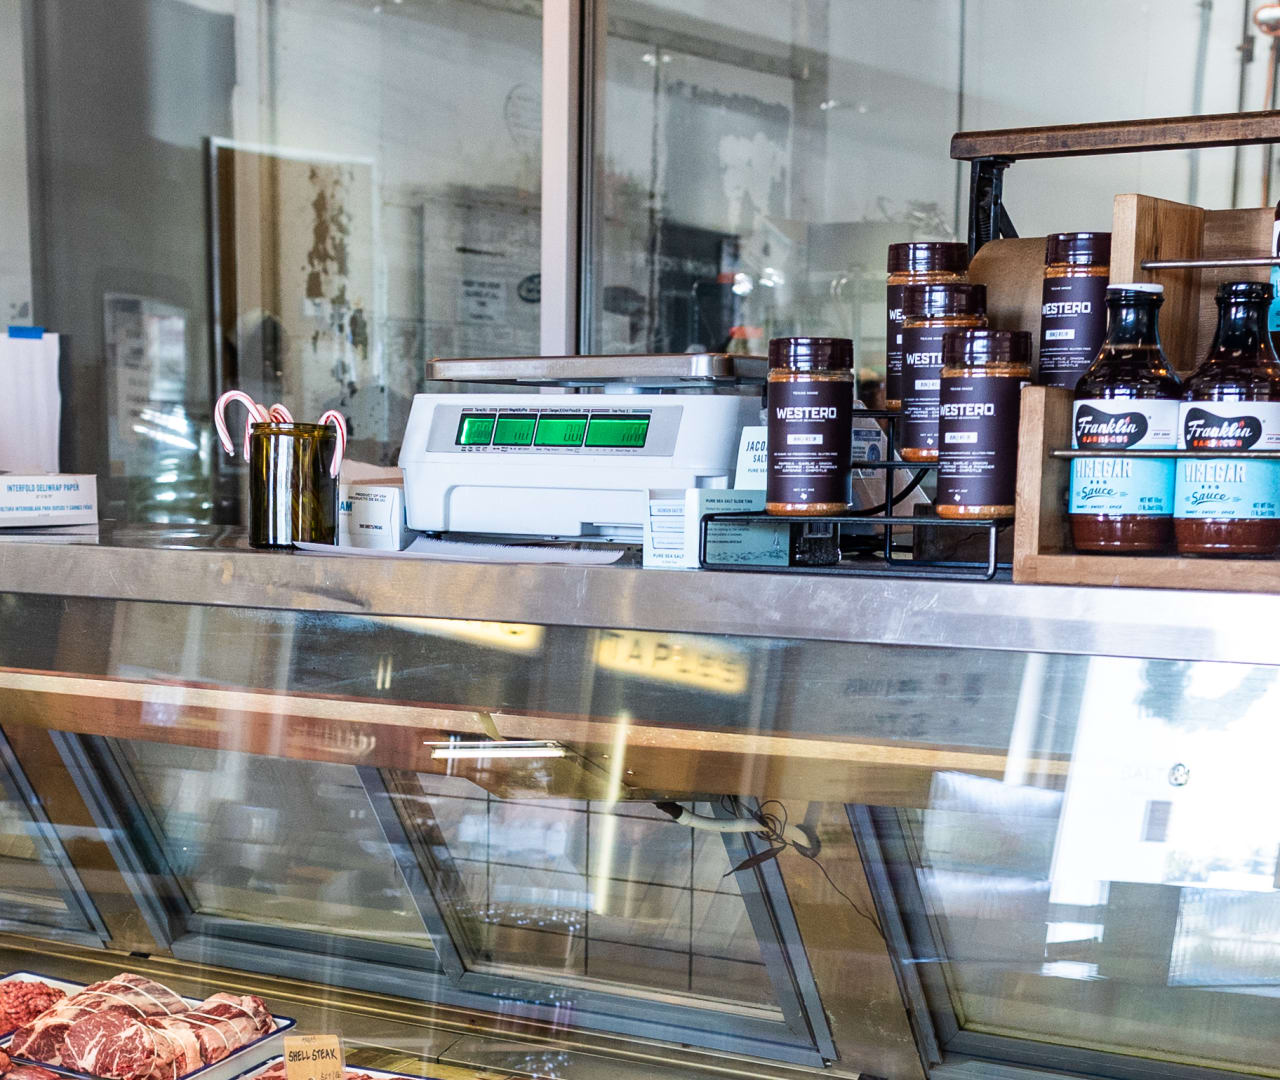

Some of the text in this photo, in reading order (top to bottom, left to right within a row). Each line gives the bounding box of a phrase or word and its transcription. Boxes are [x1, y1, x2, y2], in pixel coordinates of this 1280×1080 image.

[776, 407, 837, 419] WESTERO
[1077, 416, 1138, 437] Franklin
[1187, 419, 1252, 441] Franklin
[746, 441, 768, 452] JACO
[1075, 459, 1132, 478] VINEGAR
[1184, 463, 1246, 483] VINEGAR
[64, 483, 79, 491] PAPER
[1082, 486, 1117, 500] Sauce
[1191, 492, 1230, 506] Sauce
[288, 1048, 338, 1063] SHELL STEAK
